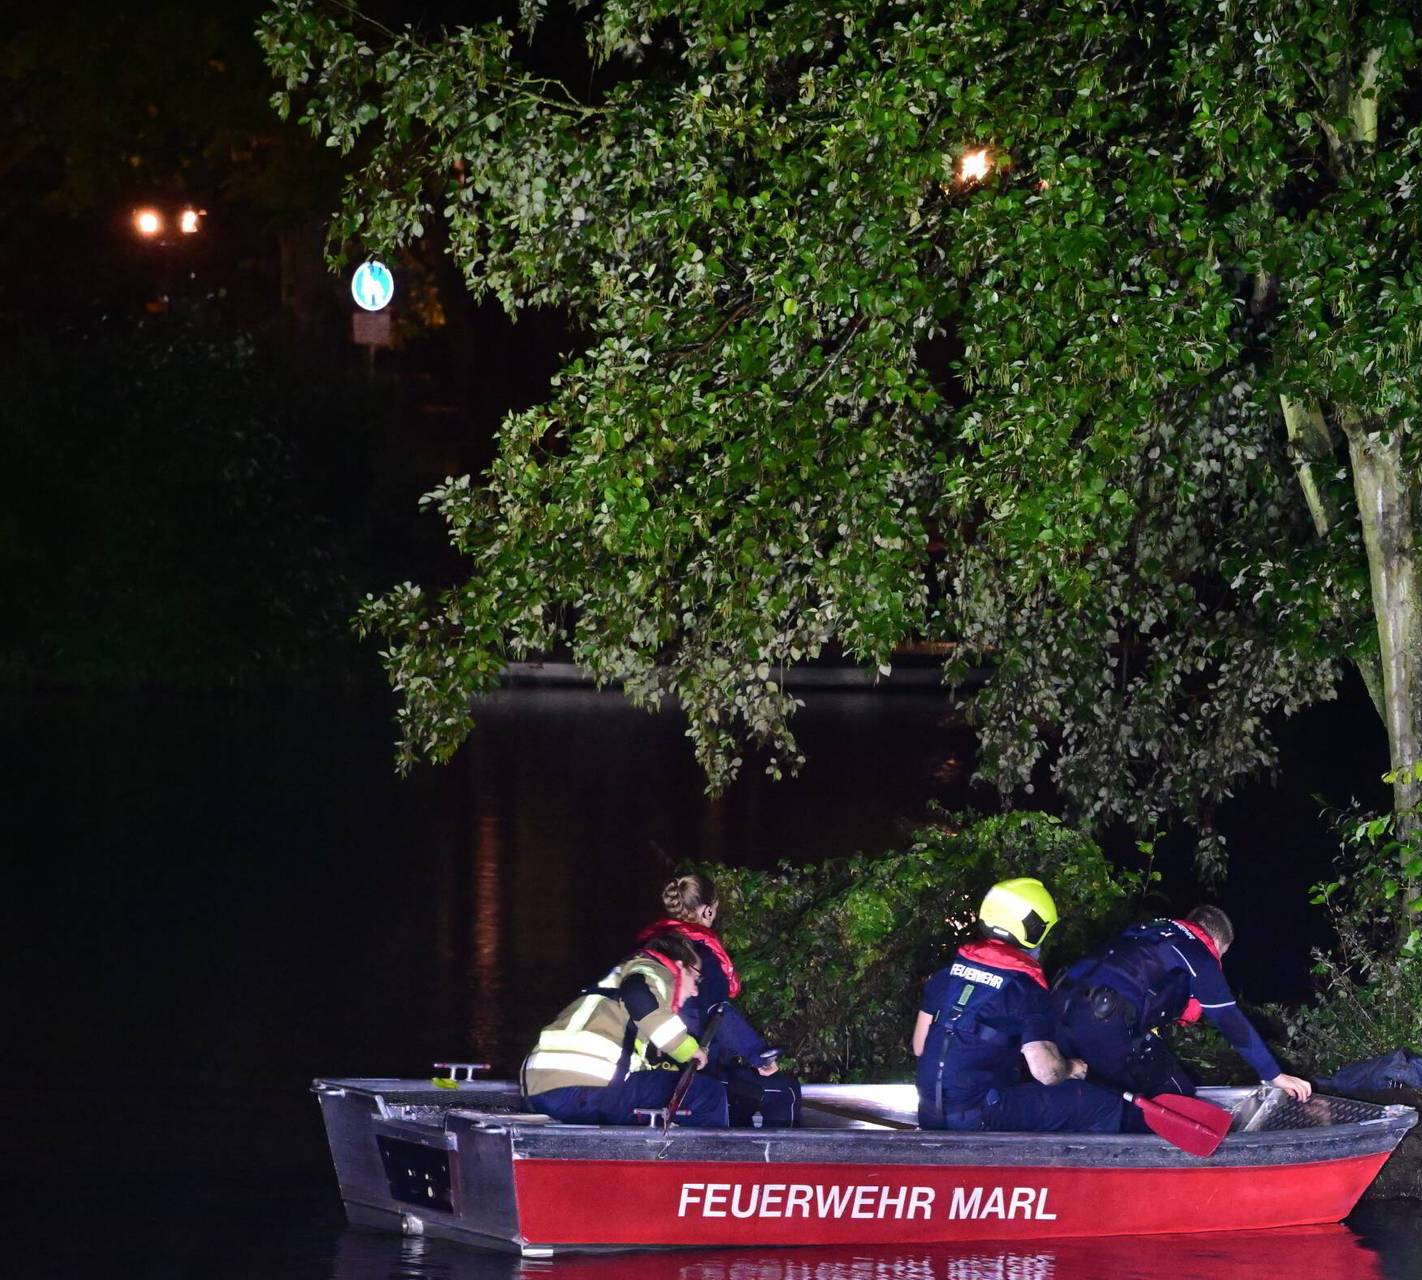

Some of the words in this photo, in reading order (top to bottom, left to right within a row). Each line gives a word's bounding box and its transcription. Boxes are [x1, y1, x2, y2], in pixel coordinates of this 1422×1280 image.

[950, 963, 1003, 989] FEUERWEHR
[678, 1183, 935, 1219] FEUERWEHR
[949, 1186, 1057, 1220] MARL
